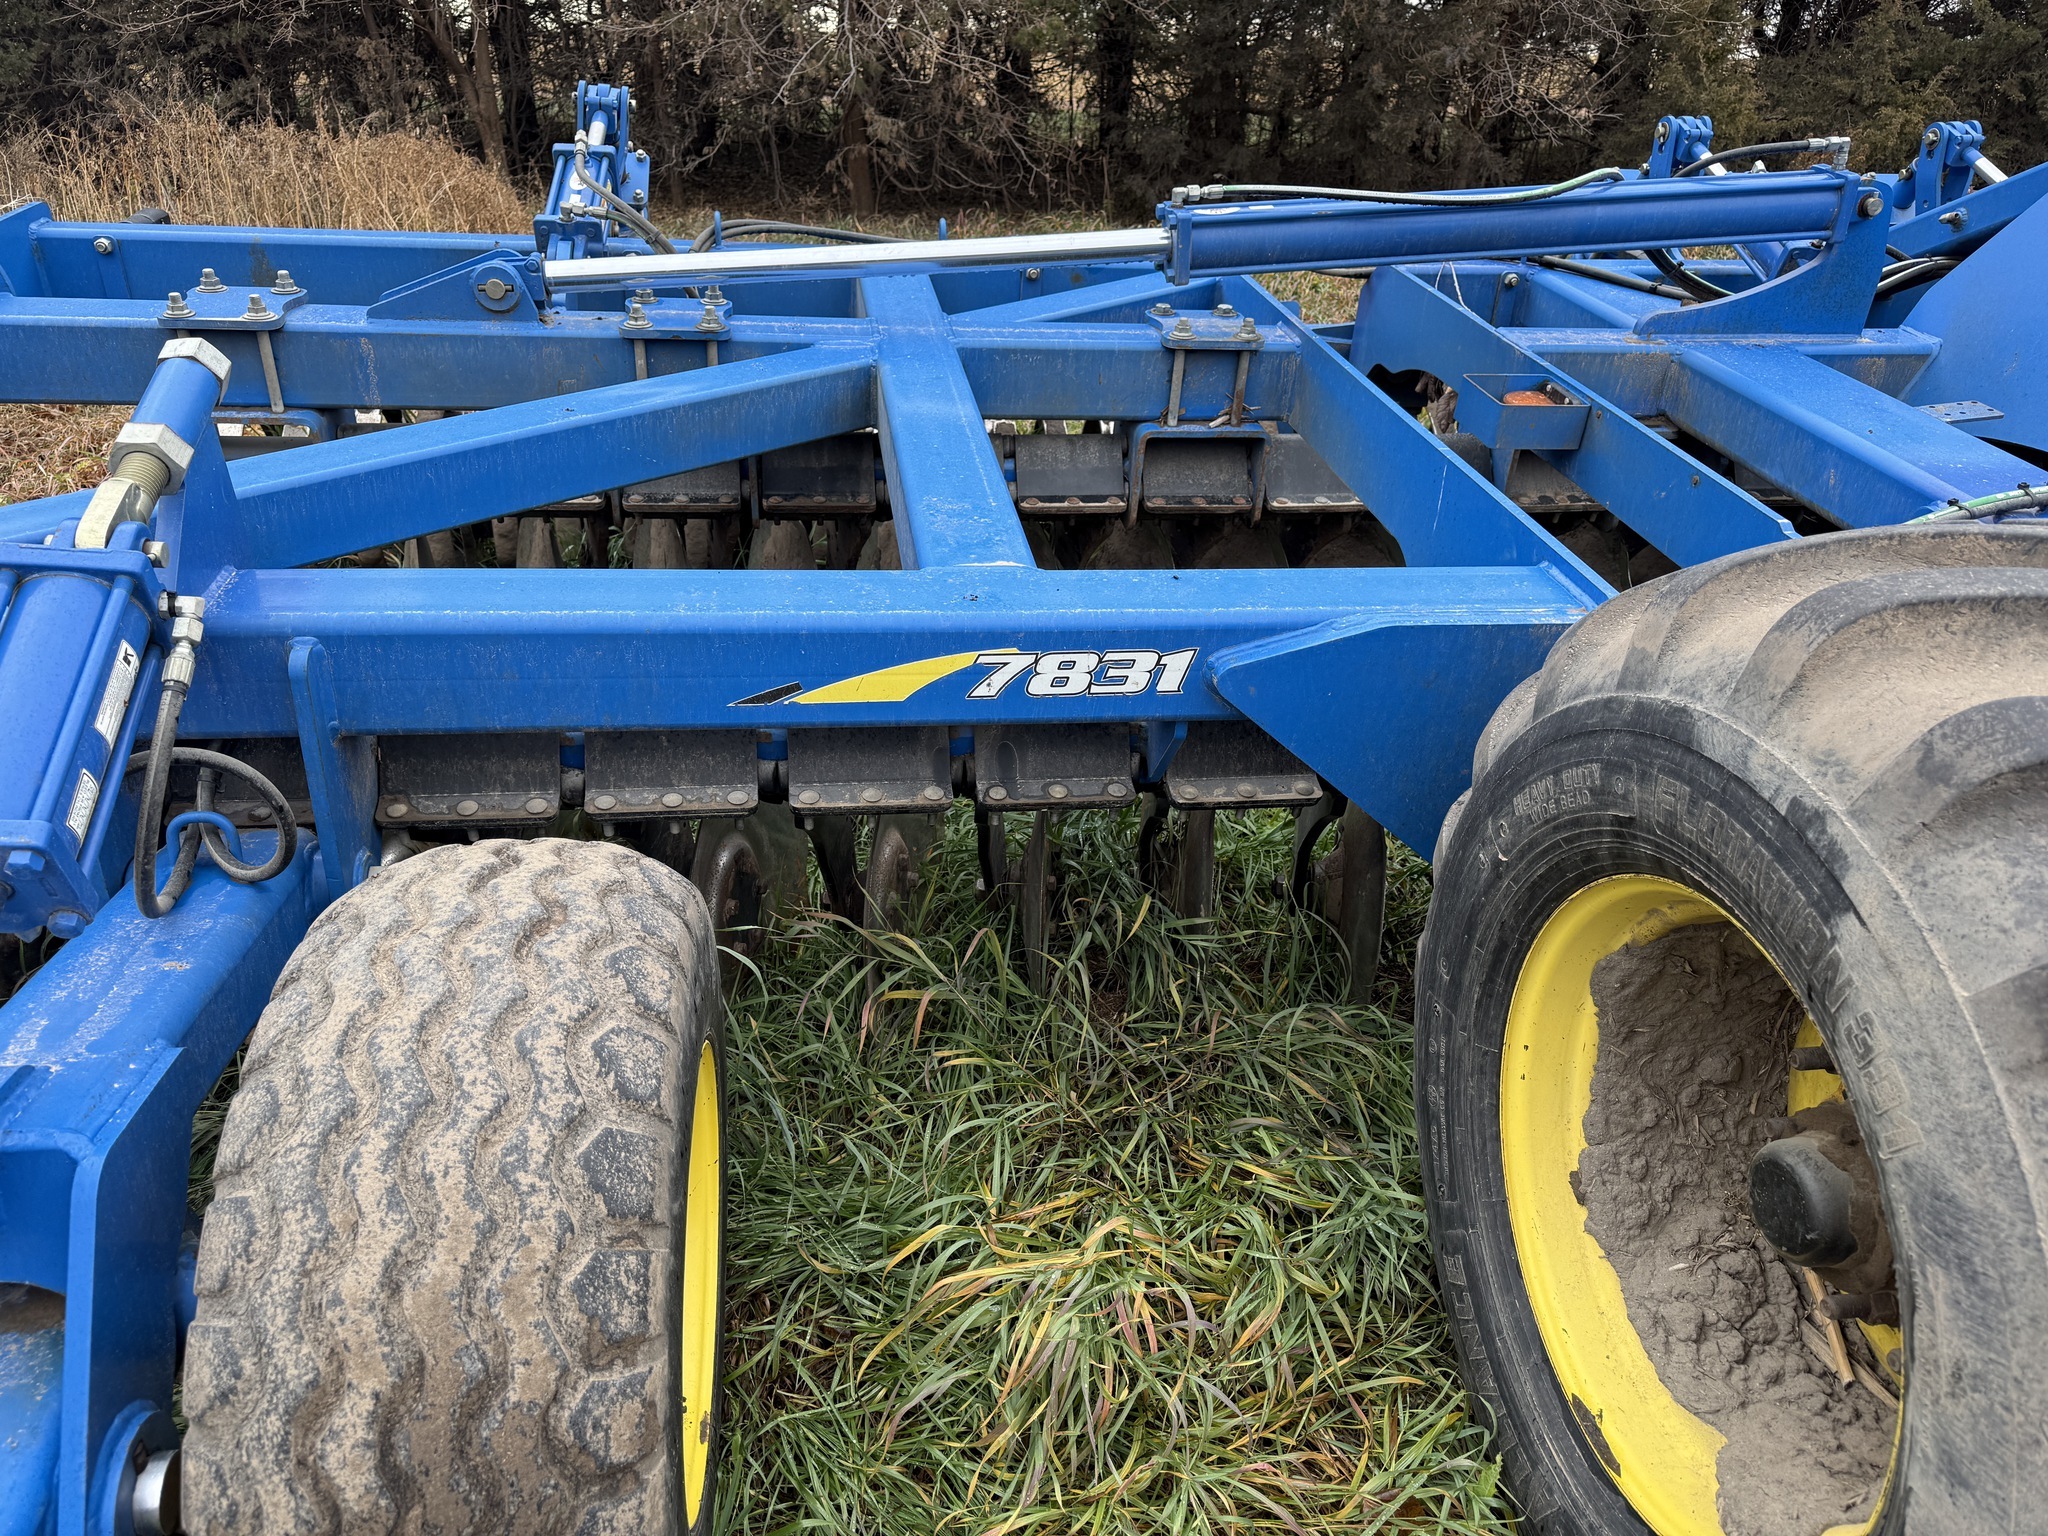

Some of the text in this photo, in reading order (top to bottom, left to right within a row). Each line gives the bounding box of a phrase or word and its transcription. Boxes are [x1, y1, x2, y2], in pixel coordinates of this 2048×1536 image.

[965, 647, 1199, 700] 7831
[1513, 763, 1601, 816] HEAVY DUTY
[1530, 790, 1590, 824] WIDE BEAD
[1654, 775, 1853, 1013] FLOTATION
